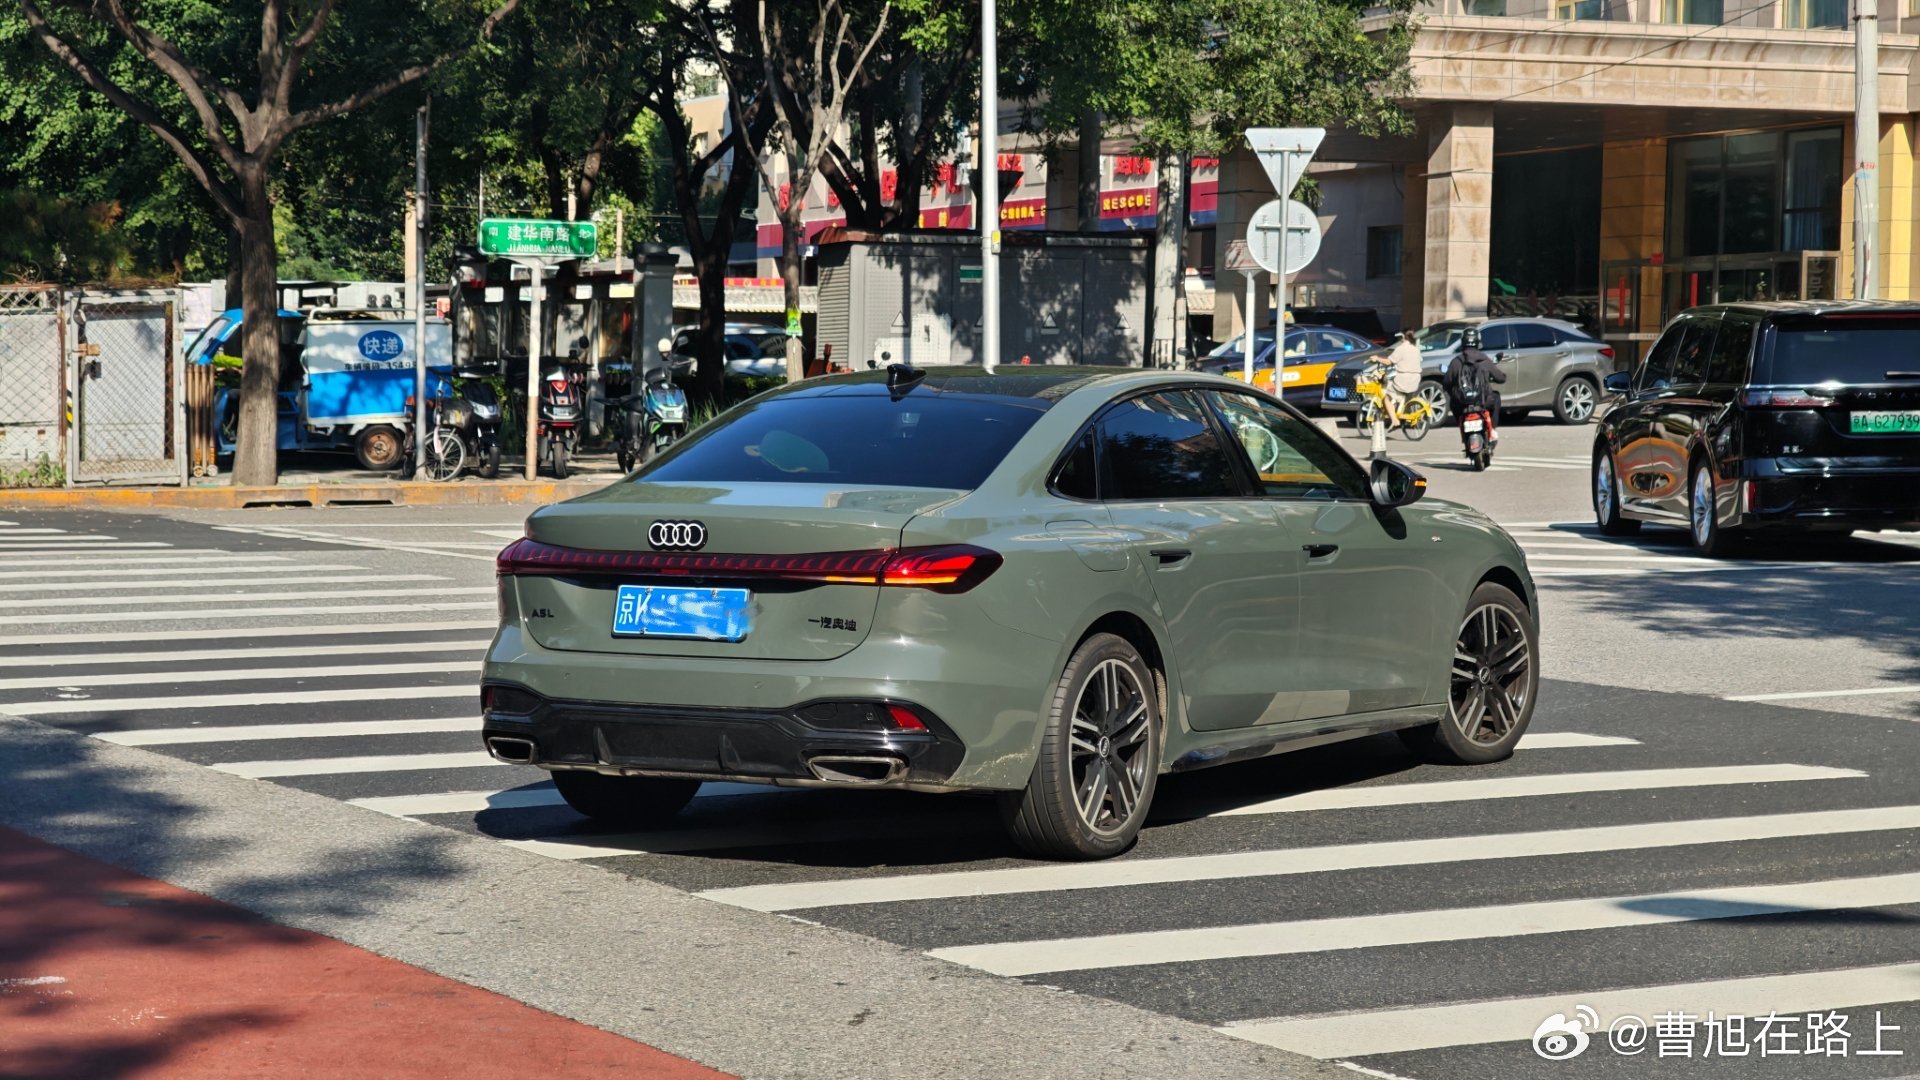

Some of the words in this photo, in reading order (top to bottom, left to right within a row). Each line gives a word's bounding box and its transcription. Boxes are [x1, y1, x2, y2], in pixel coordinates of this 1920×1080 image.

[1103, 194, 1152, 211] RESCUE
[1001, 205, 1035, 220] CHINA
[507, 225, 570, 241] 建华南路
[507, 243, 541, 253] JIANHUA
[363, 337, 399, 355] 快递
[531, 608, 554, 618] A5L
[808, 616, 856, 631] 一汽奥迪
